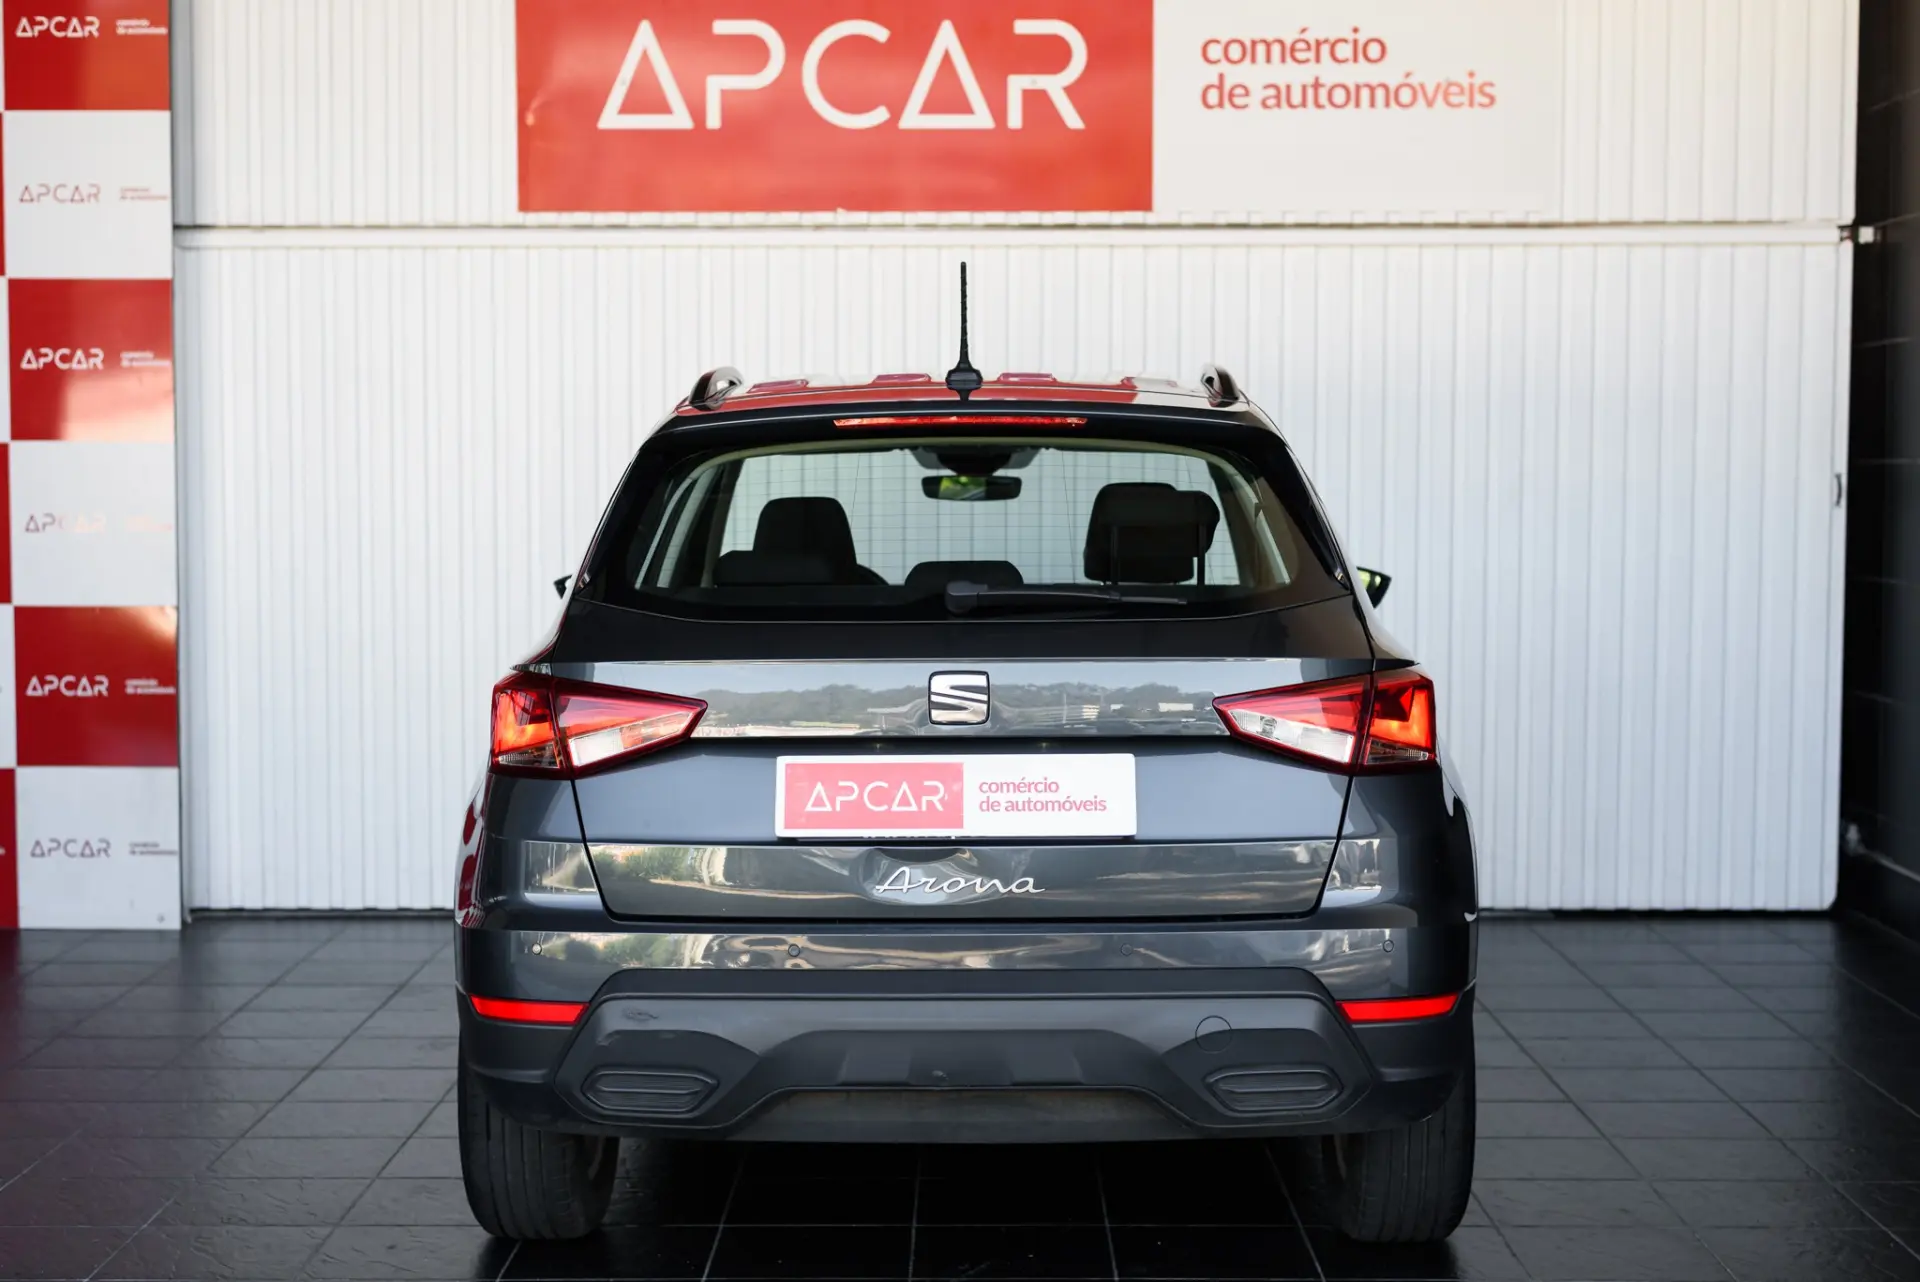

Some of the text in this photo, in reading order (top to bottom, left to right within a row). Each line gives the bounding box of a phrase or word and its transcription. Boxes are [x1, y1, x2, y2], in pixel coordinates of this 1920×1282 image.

[15, 15, 101, 38] APCAR
[1200, 26, 1388, 65] comércio
[597, 19, 1088, 130] APCAR
[1200, 70, 1497, 110] de automóveis
[19, 183, 101, 203] APCAR
[20, 347, 105, 371] APCAR
[25, 674, 110, 697] APCAR
[804, 780, 947, 812] APCAR
[978, 776, 1060, 794] comércio
[978, 795, 1107, 812] de automóveis
[29, 838, 112, 859] APCAR
[875, 866, 1046, 895] Arona
